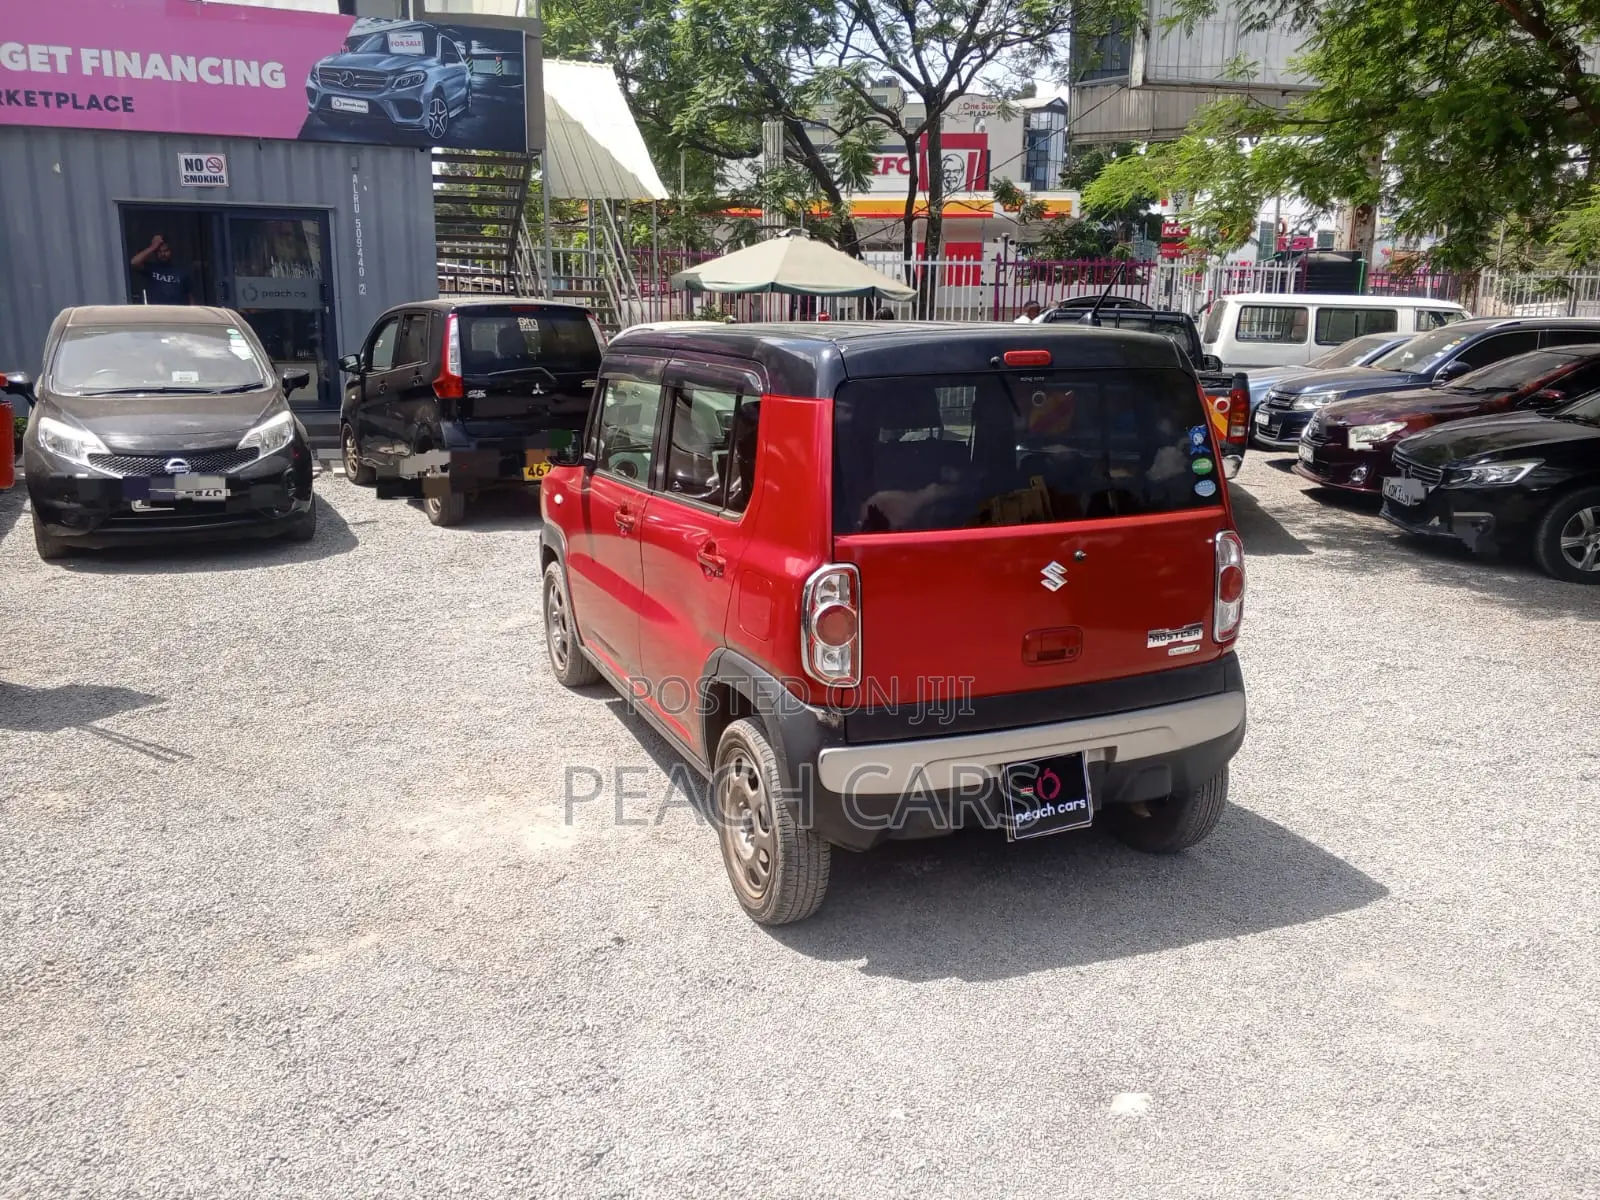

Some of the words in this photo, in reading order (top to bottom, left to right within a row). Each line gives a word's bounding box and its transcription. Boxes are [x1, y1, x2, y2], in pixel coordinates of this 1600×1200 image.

[0, 42, 72, 74] GET
[80, 48, 286, 89] FINANCING
[0, 89, 135, 113] KETPLACE
[184, 158, 204, 172] NO
[183, 174, 225, 184] SMOKING
[1164, 226, 1188, 234] KFC
[1015, 802, 1056, 828] peach
[1057, 799, 1086, 814] cars
